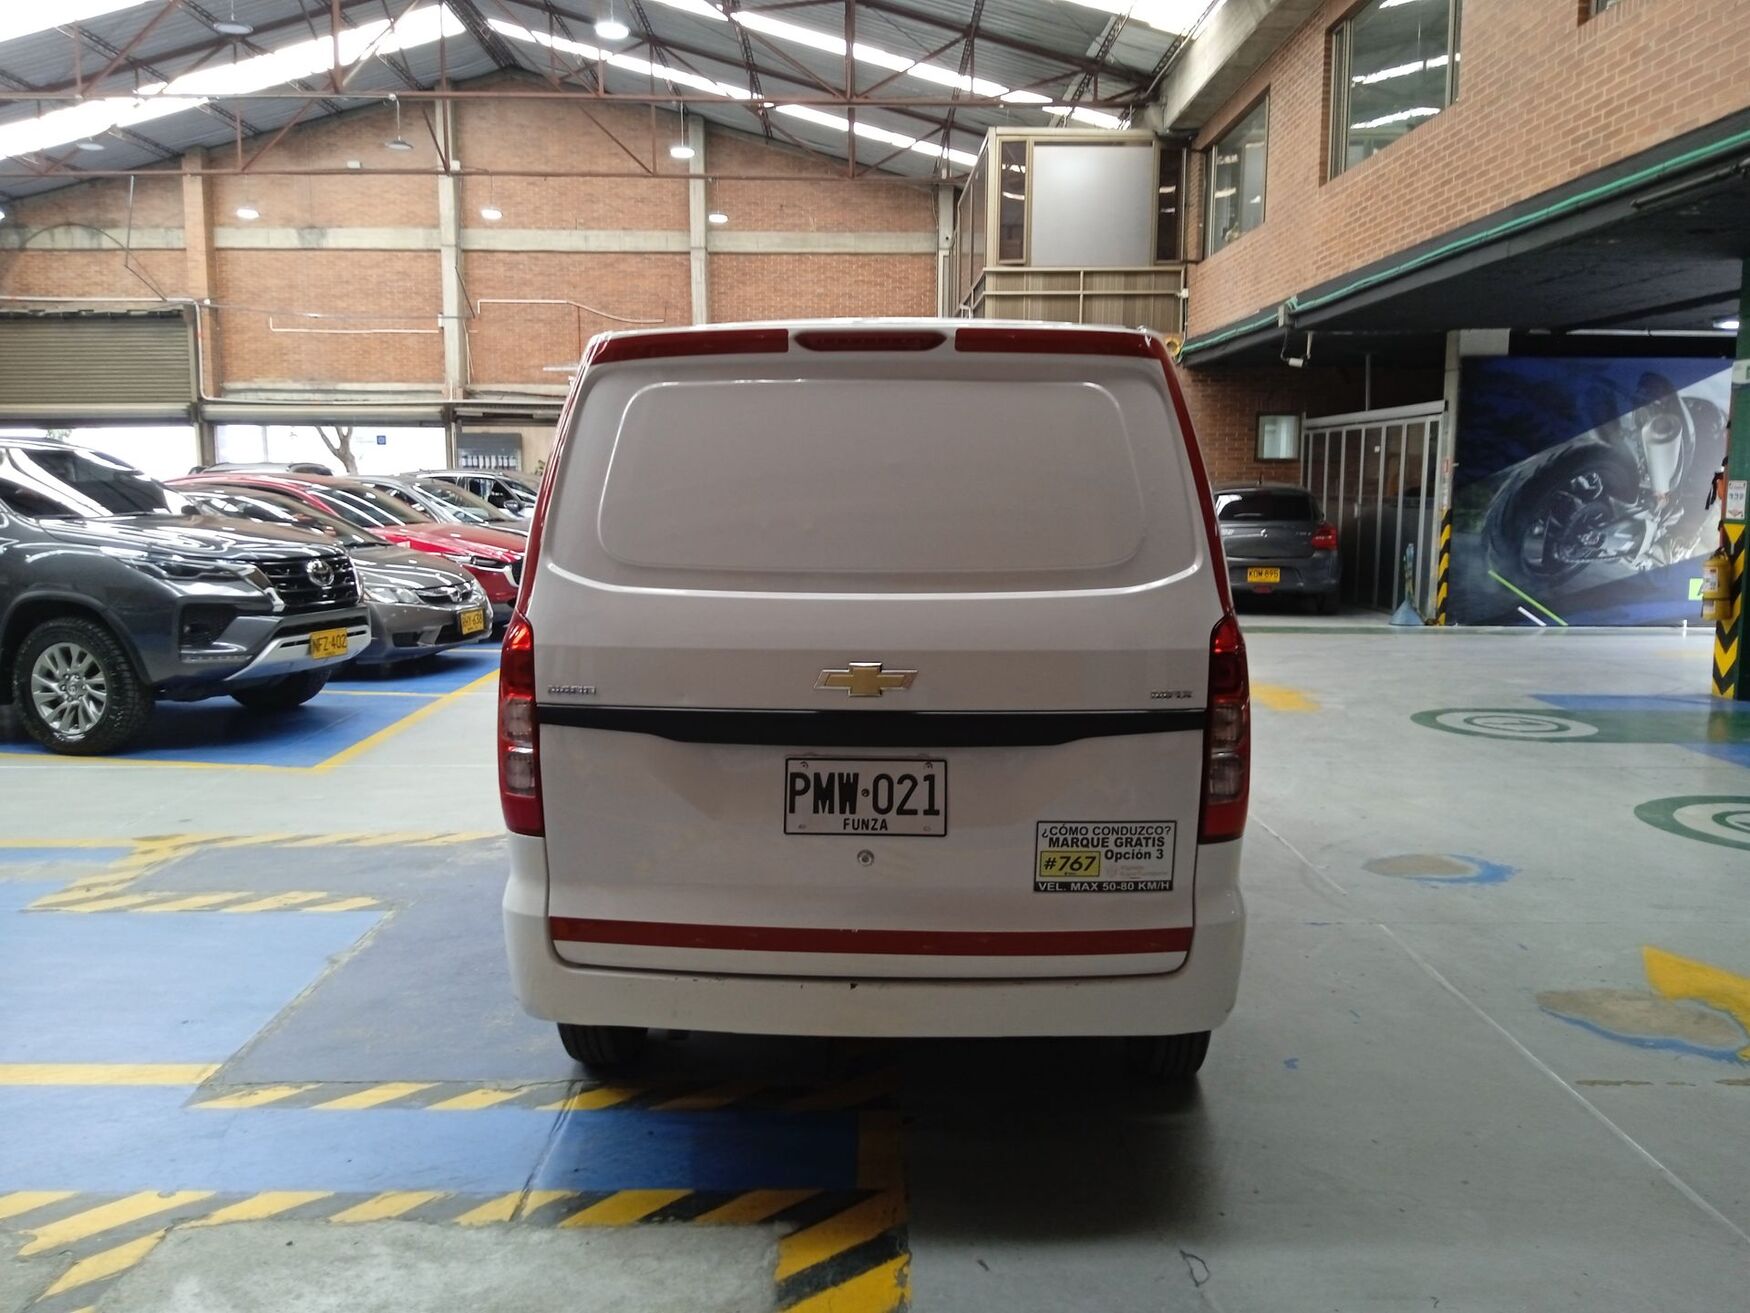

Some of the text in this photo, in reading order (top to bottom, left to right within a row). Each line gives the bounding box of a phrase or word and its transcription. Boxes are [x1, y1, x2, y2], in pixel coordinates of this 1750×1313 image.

[843, 818, 888, 831] FUNZA
[1041, 823, 1171, 838] ¿CÓMO CONDUZCO?
[1048, 836, 1165, 849] MARQUE GRATIS
[1104, 849, 1164, 862] Opción 3
[1044, 856, 1096, 871] #767
[1039, 881, 1170, 891] VEL. MAX 50-80 KM/H
